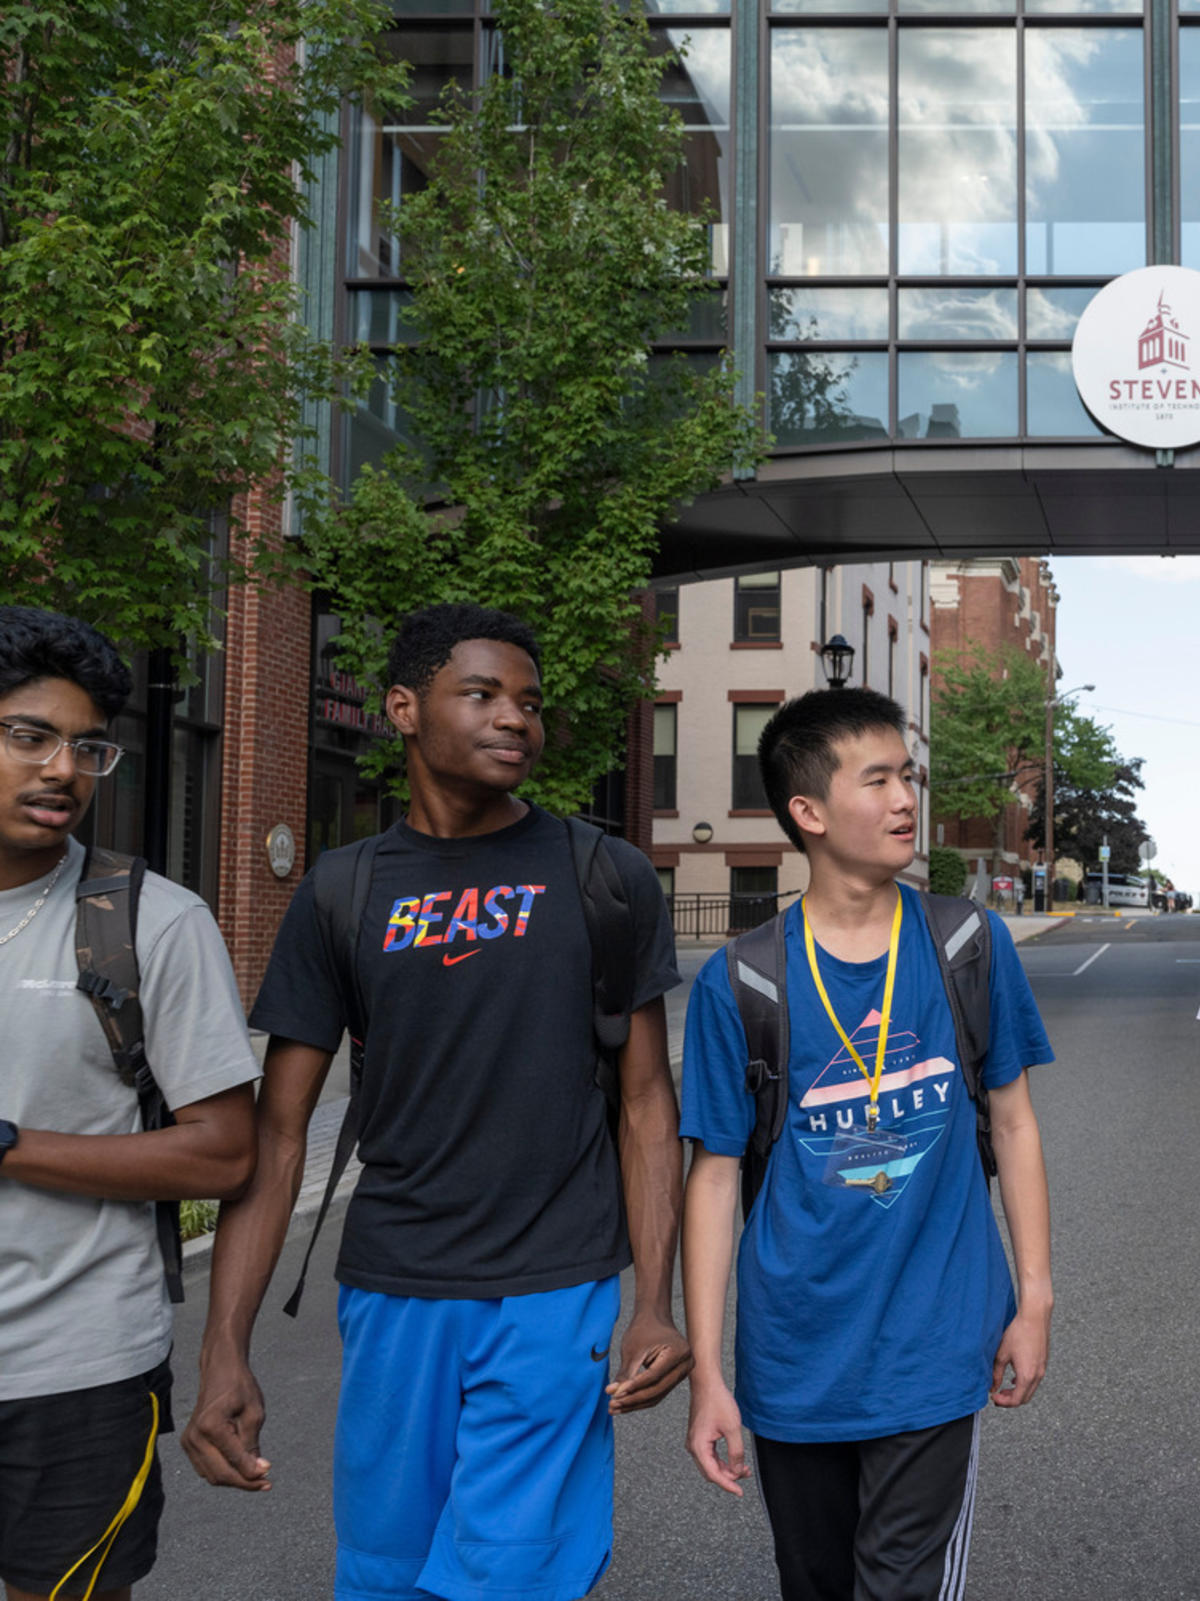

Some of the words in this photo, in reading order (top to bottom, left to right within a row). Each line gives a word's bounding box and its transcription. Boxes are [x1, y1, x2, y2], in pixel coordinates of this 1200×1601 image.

[1109, 403, 1151, 411] INSTITUTE
[1153, 403, 1165, 411] OF
[383, 885, 547, 953] BEAST
[808, 1081, 951, 1133] HURLEY
